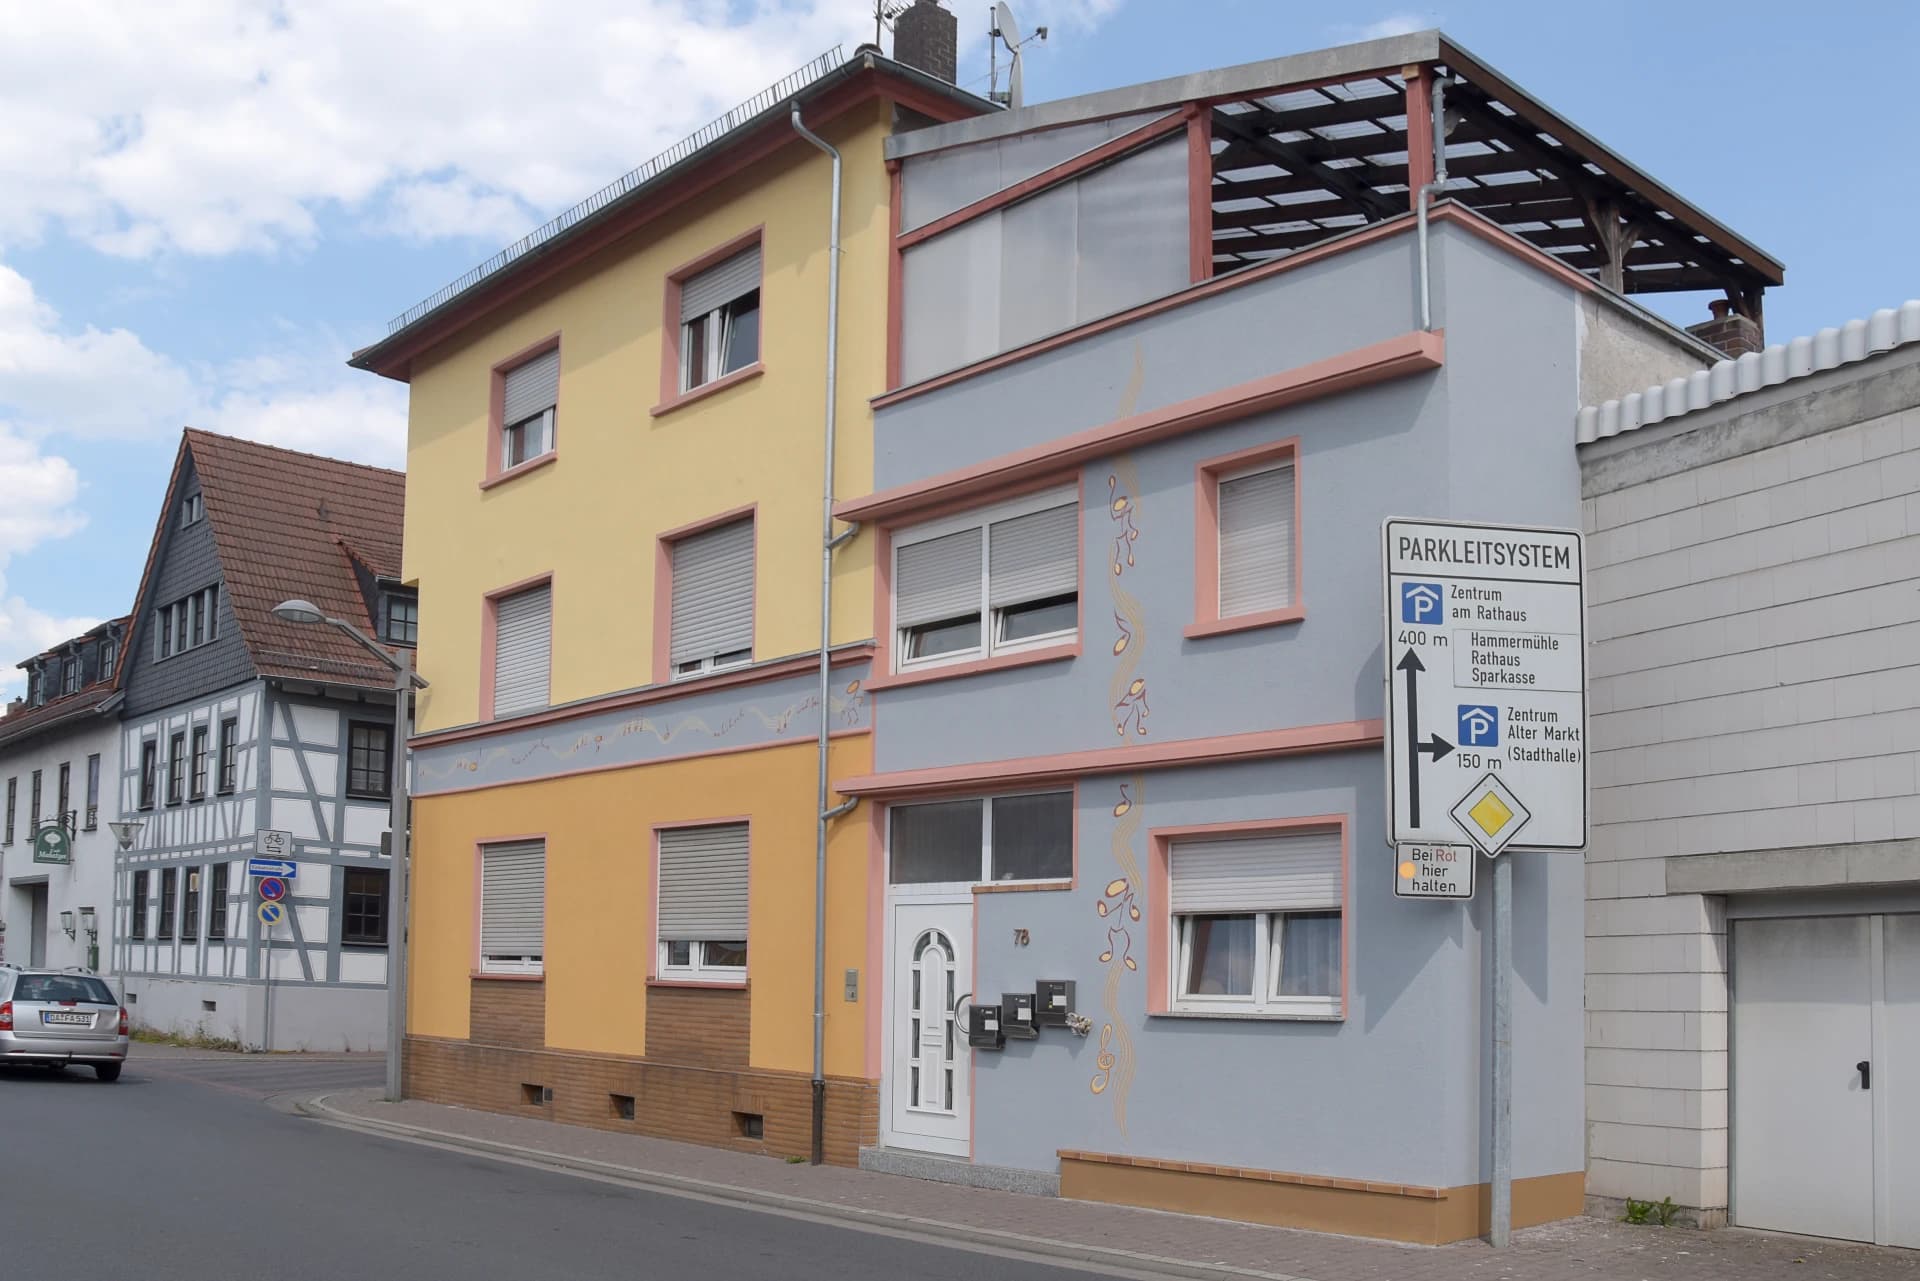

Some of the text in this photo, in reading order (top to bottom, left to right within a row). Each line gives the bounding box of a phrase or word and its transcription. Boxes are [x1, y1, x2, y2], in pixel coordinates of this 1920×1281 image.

[1399, 536, 1570, 569] PARKLEITSYSTEM
[1451, 585, 1502, 601] Zentrum
[1452, 605, 1527, 622] am Rathaus
[1398, 630, 1448, 646] 400 m
[1471, 632, 1559, 650] Hammermühle
[1471, 650, 1521, 666] Rathaus
[1472, 668, 1536, 686] Sparkasse
[1507, 707, 1558, 722] Zentrum
[1507, 725, 1580, 741] Alter Markt
[1457, 753, 1502, 769] 150 m
[1507, 746, 1581, 763] (Stadthalle)
[1412, 848, 1433, 861] Bei
[1422, 864, 1448, 877] hier
[1412, 878, 1456, 893] halten
